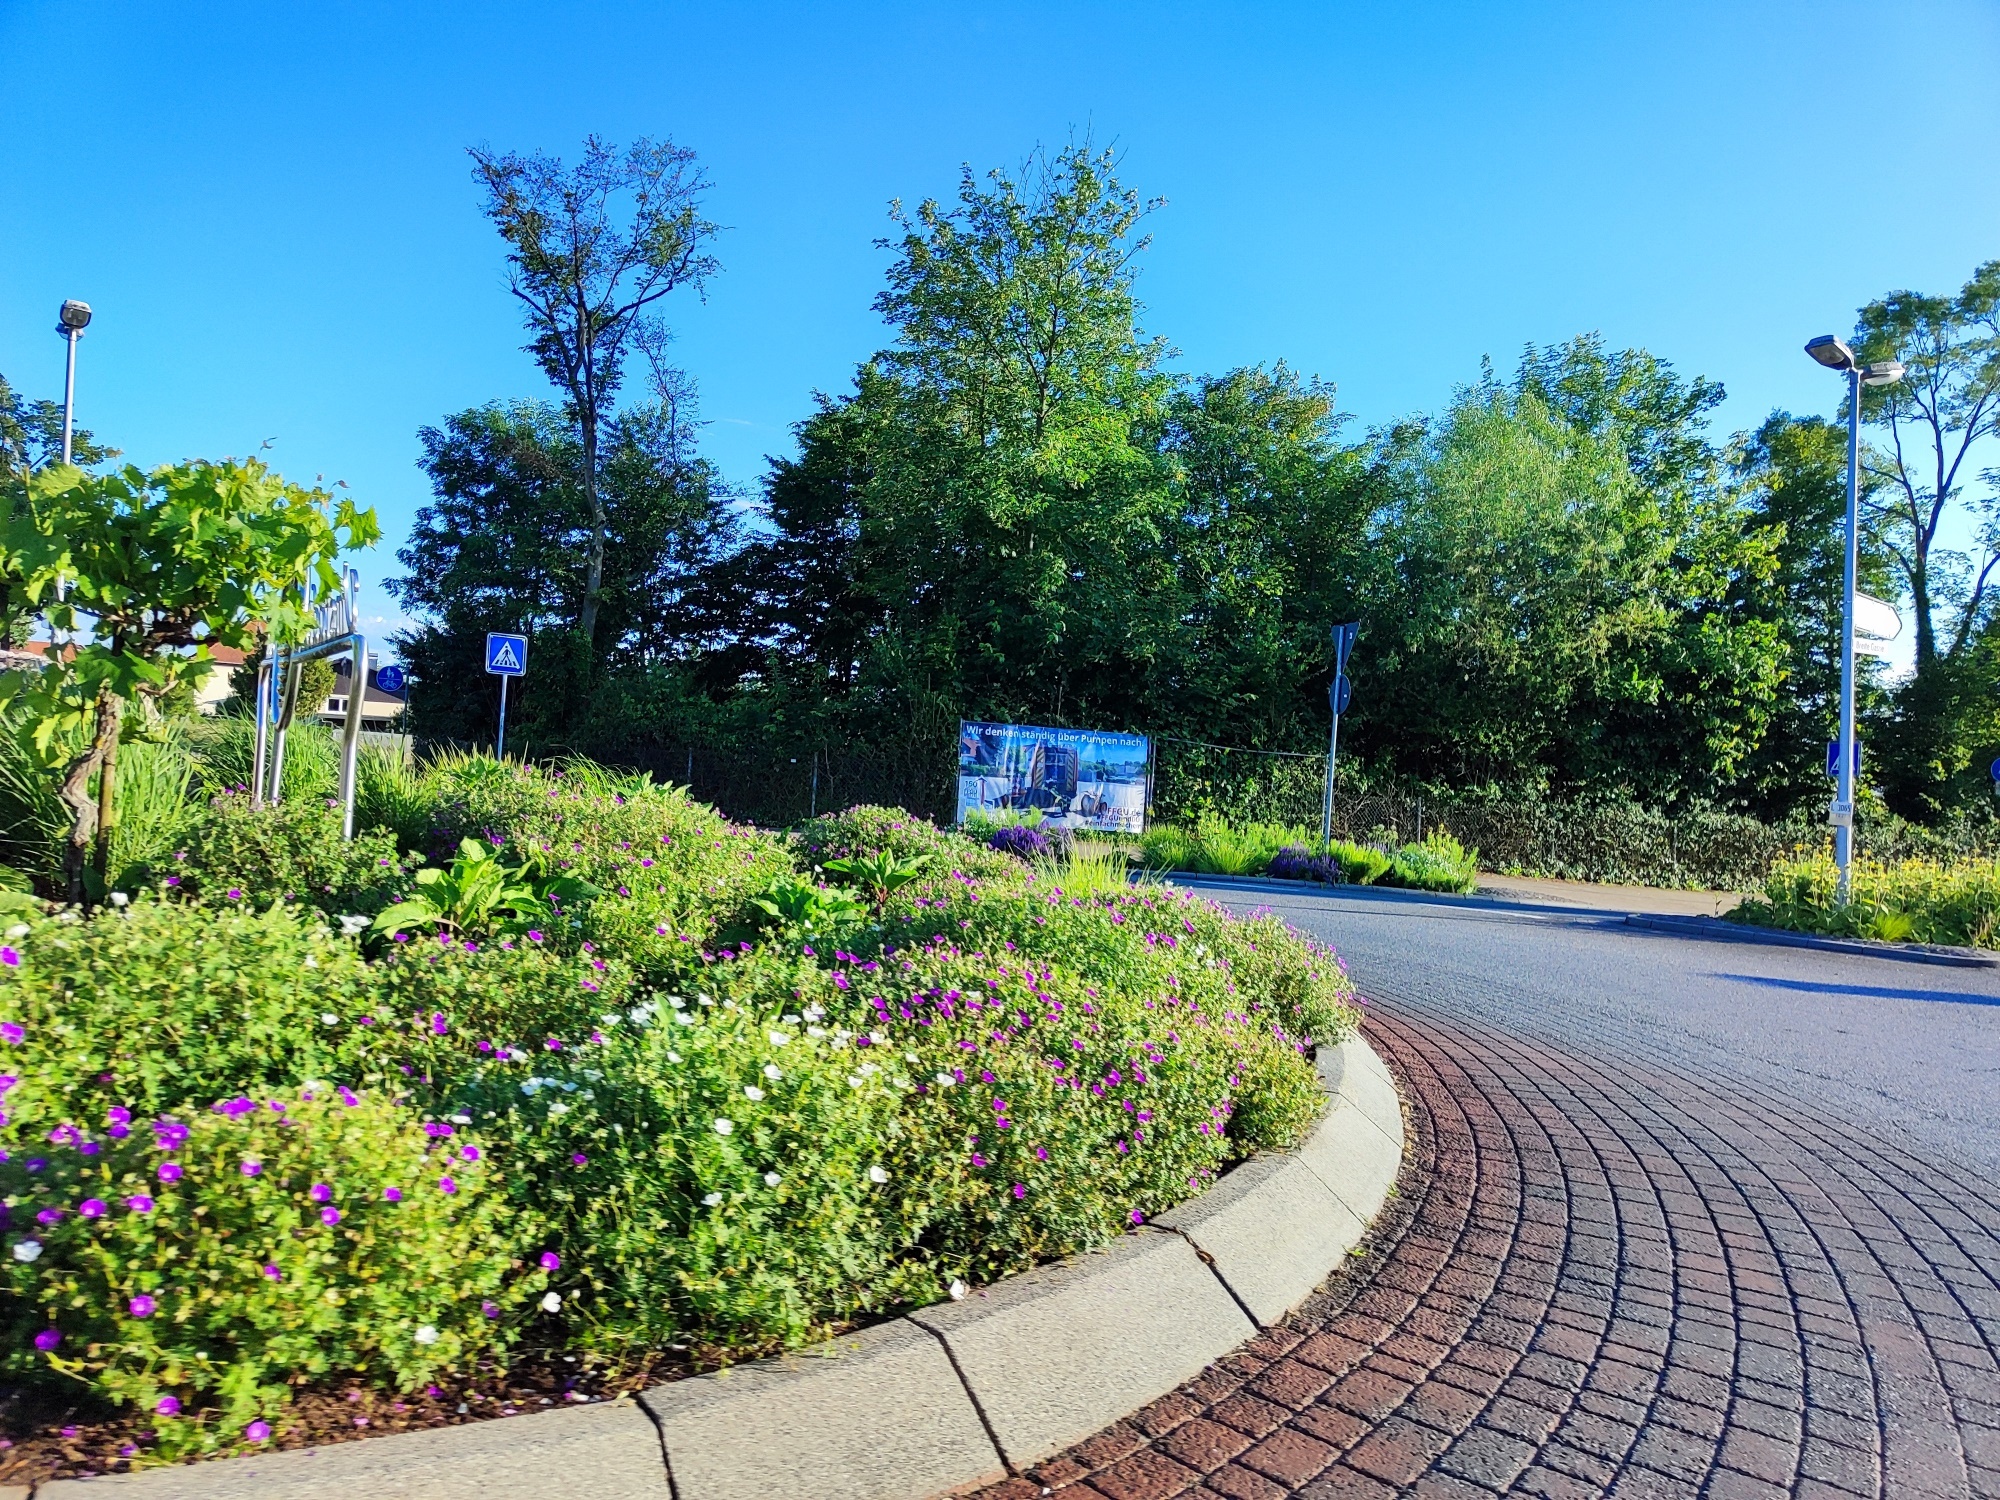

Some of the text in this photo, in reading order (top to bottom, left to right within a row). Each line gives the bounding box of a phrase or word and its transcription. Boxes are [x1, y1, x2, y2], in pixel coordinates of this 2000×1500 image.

[966, 725, 1144, 747] Wir denken ständig über Pumpen nach.
